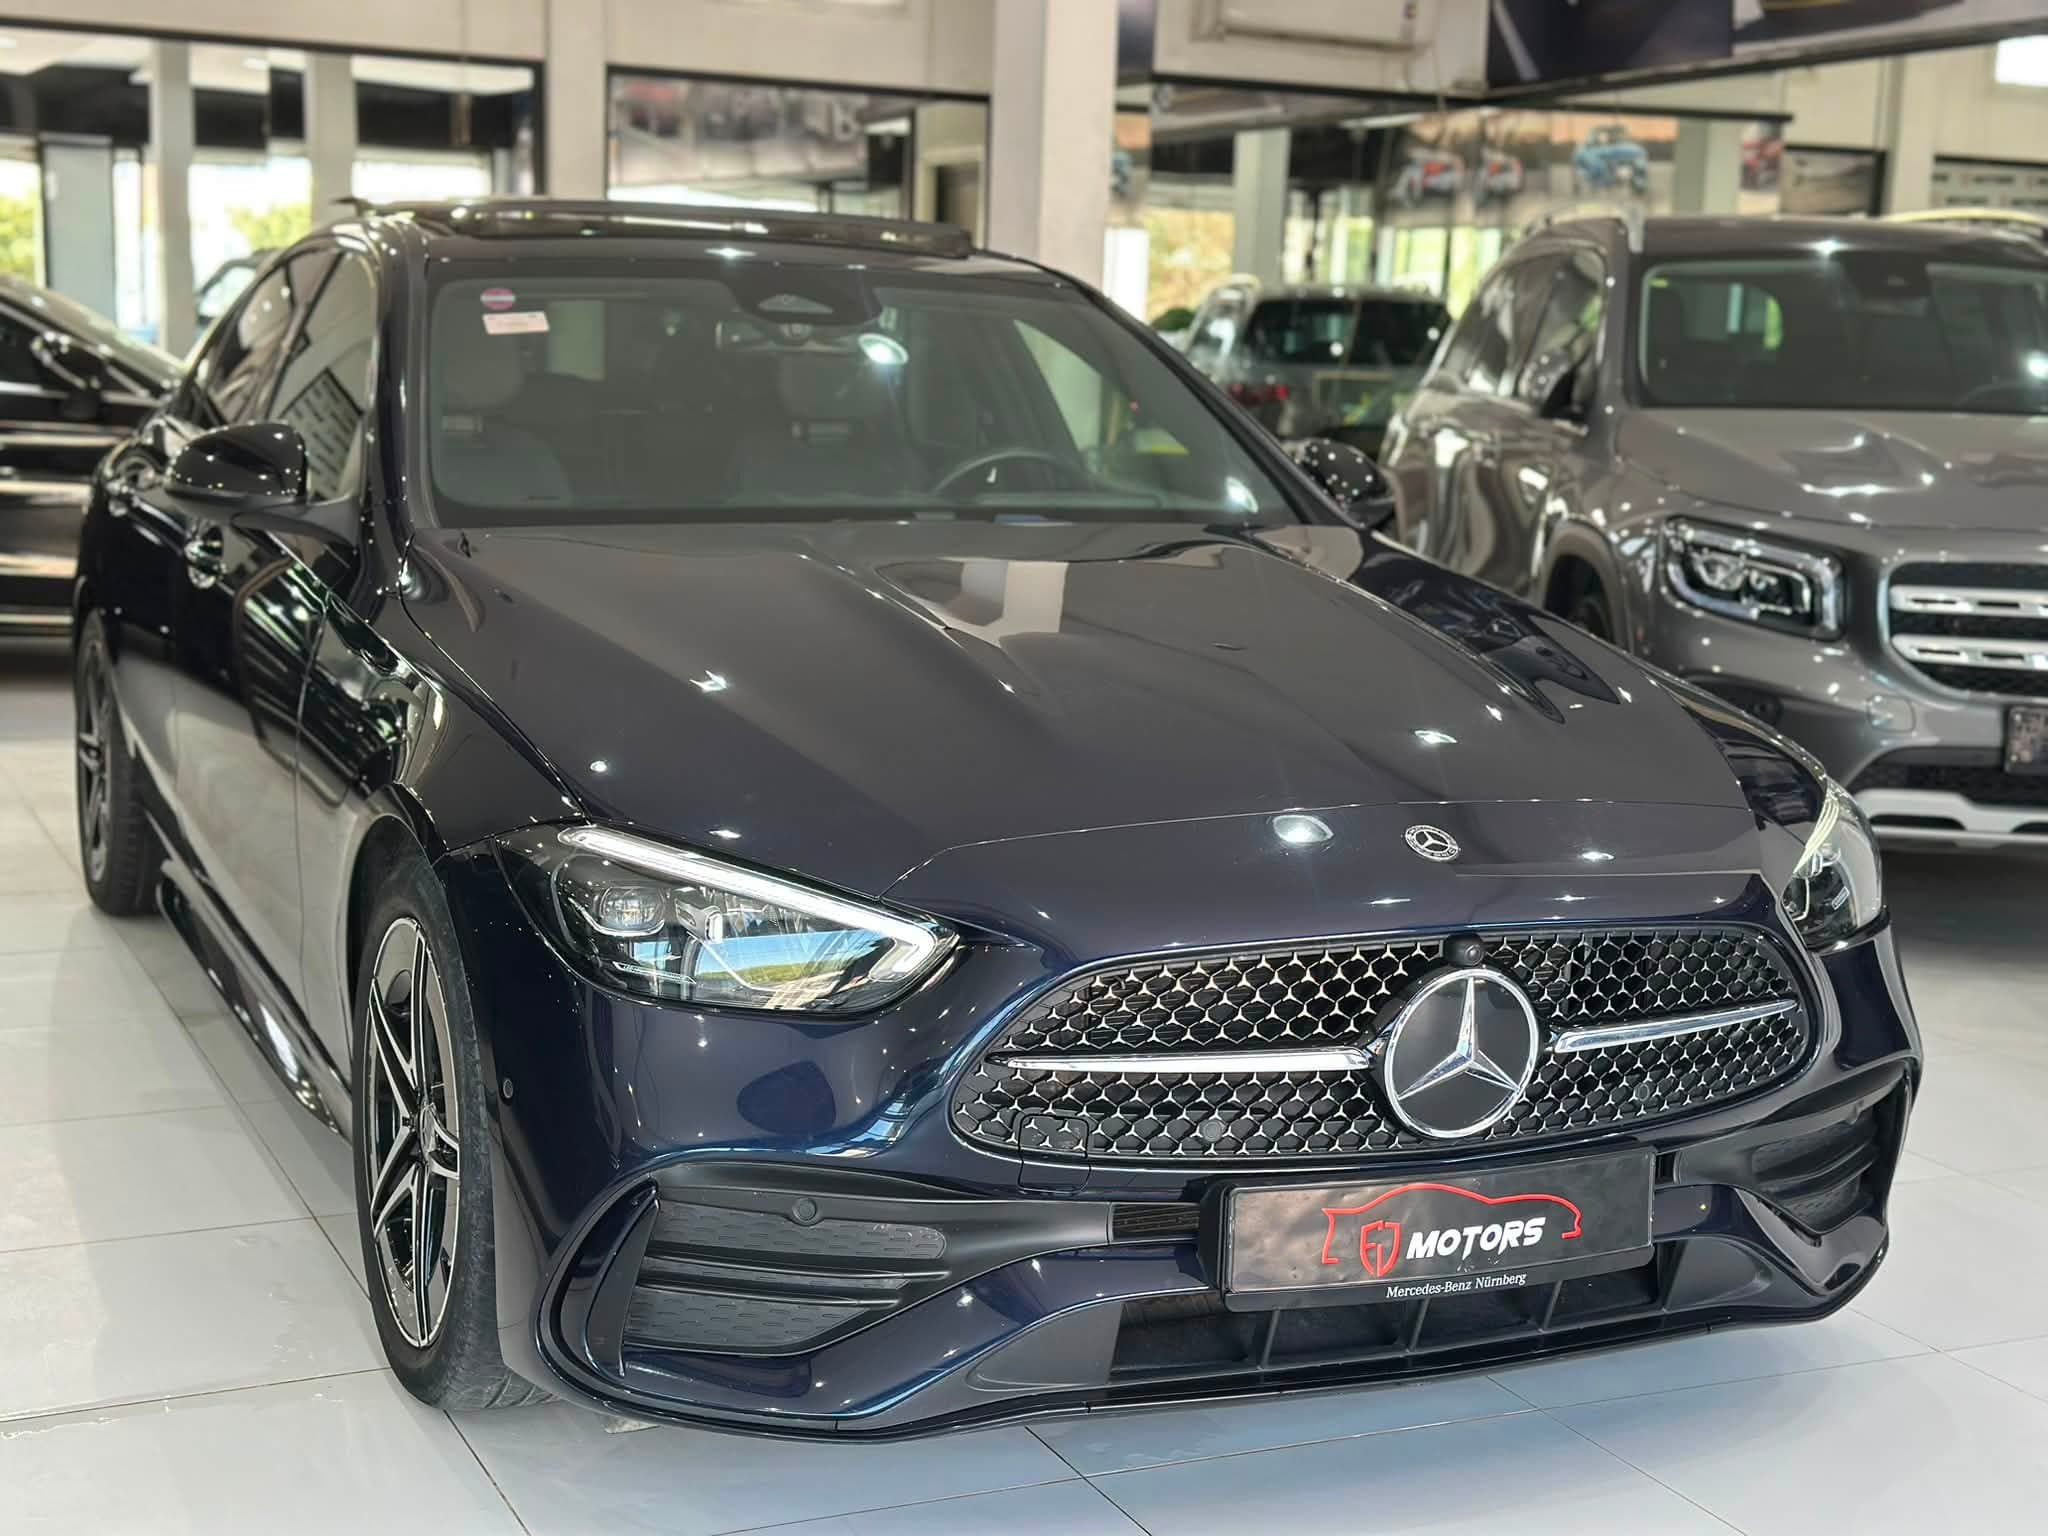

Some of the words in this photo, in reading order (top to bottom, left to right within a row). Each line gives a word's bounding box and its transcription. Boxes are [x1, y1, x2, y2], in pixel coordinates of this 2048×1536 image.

[1406, 1217, 1546, 1260] MOTORS
[1386, 1280, 1472, 1298] Mercedes-Benz
[1475, 1273, 1527, 1288] Nürnberg
